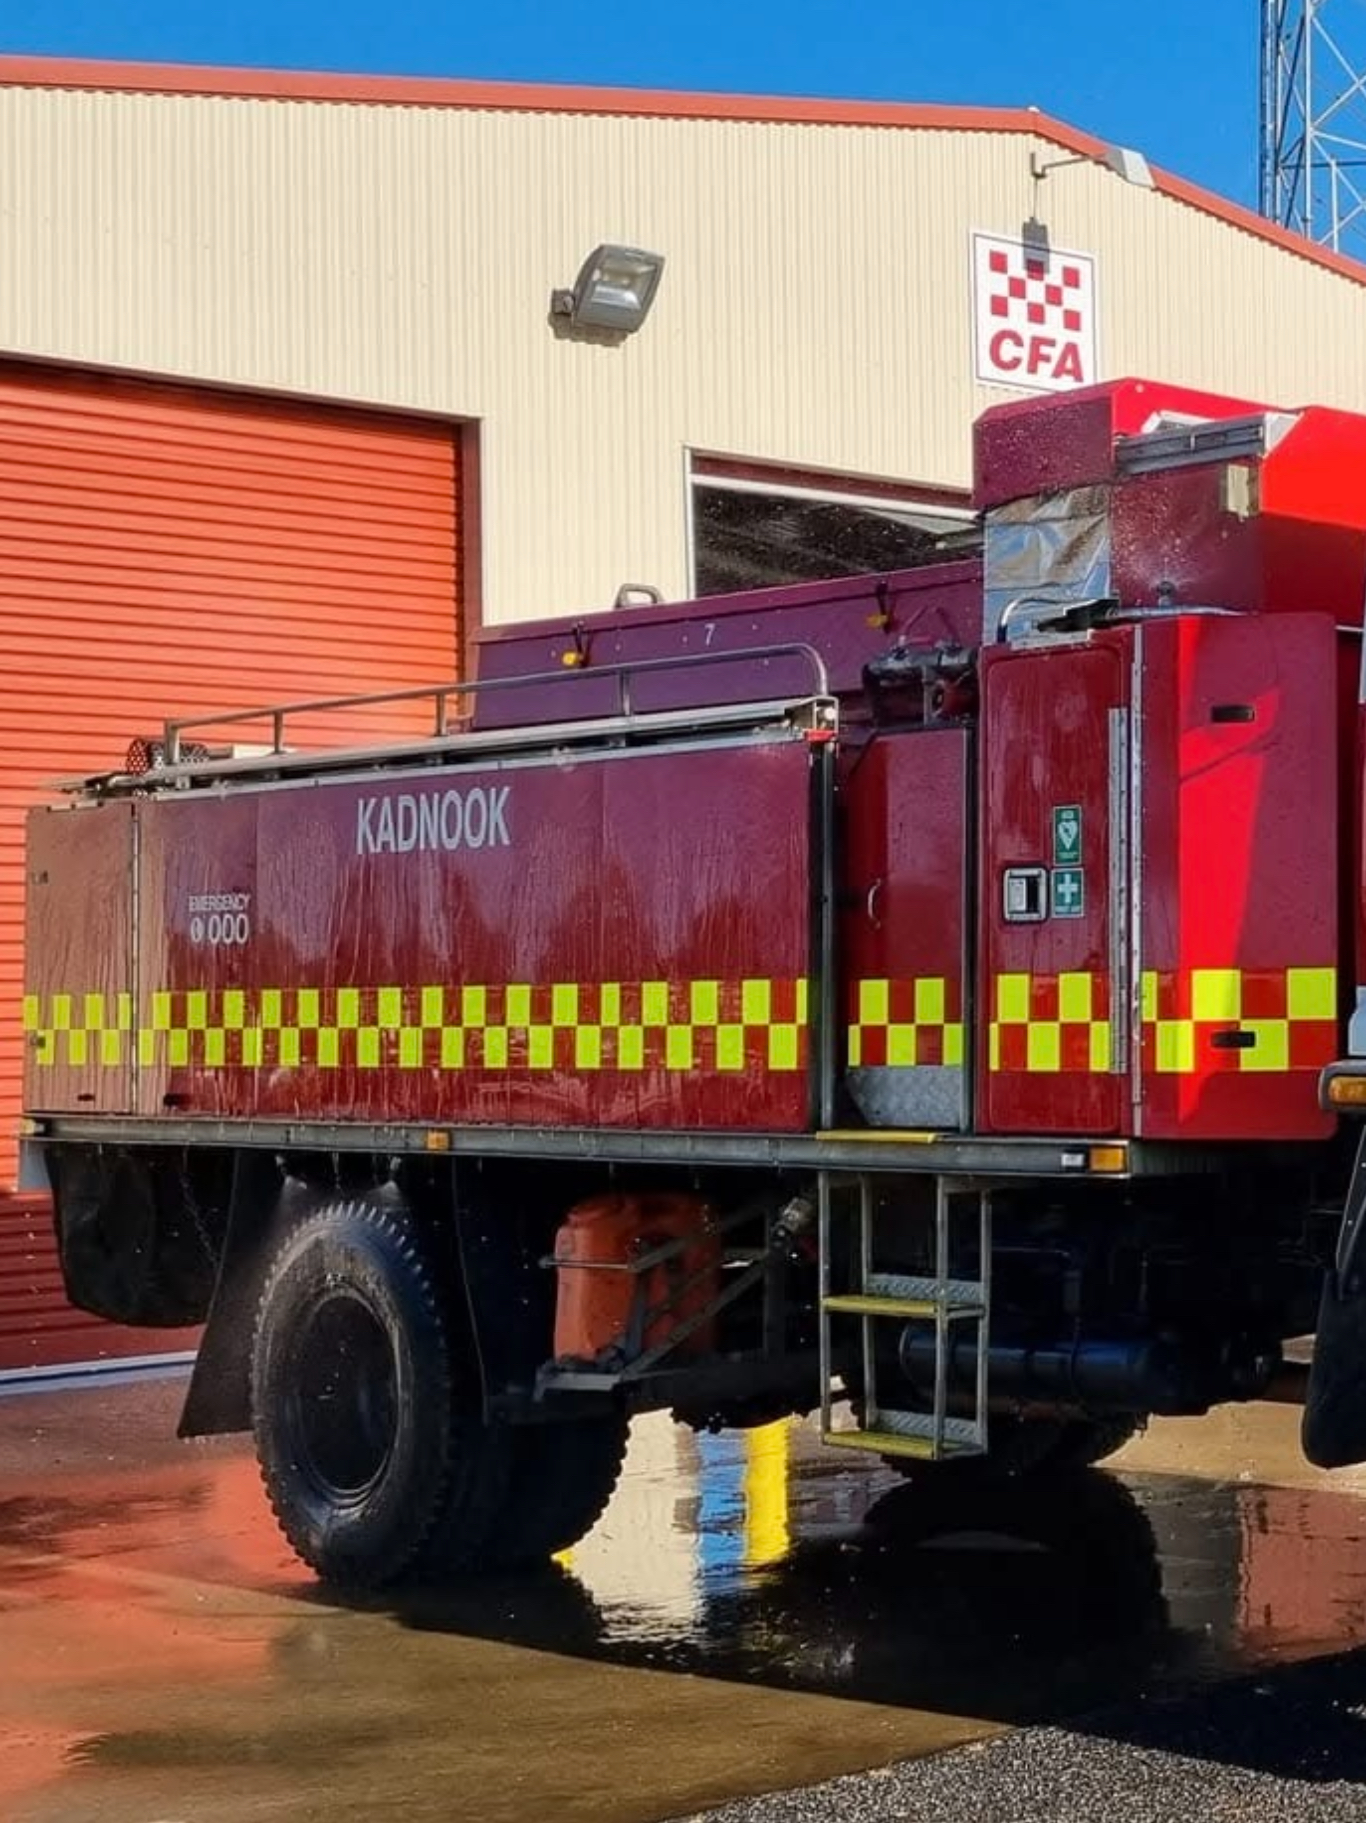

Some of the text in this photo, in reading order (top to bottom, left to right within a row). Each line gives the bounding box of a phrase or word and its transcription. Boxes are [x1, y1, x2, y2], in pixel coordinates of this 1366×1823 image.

[989, 327, 1084, 383] CFA
[356, 786, 511, 855] KADNOOK
[208, 913, 249, 944] 000
